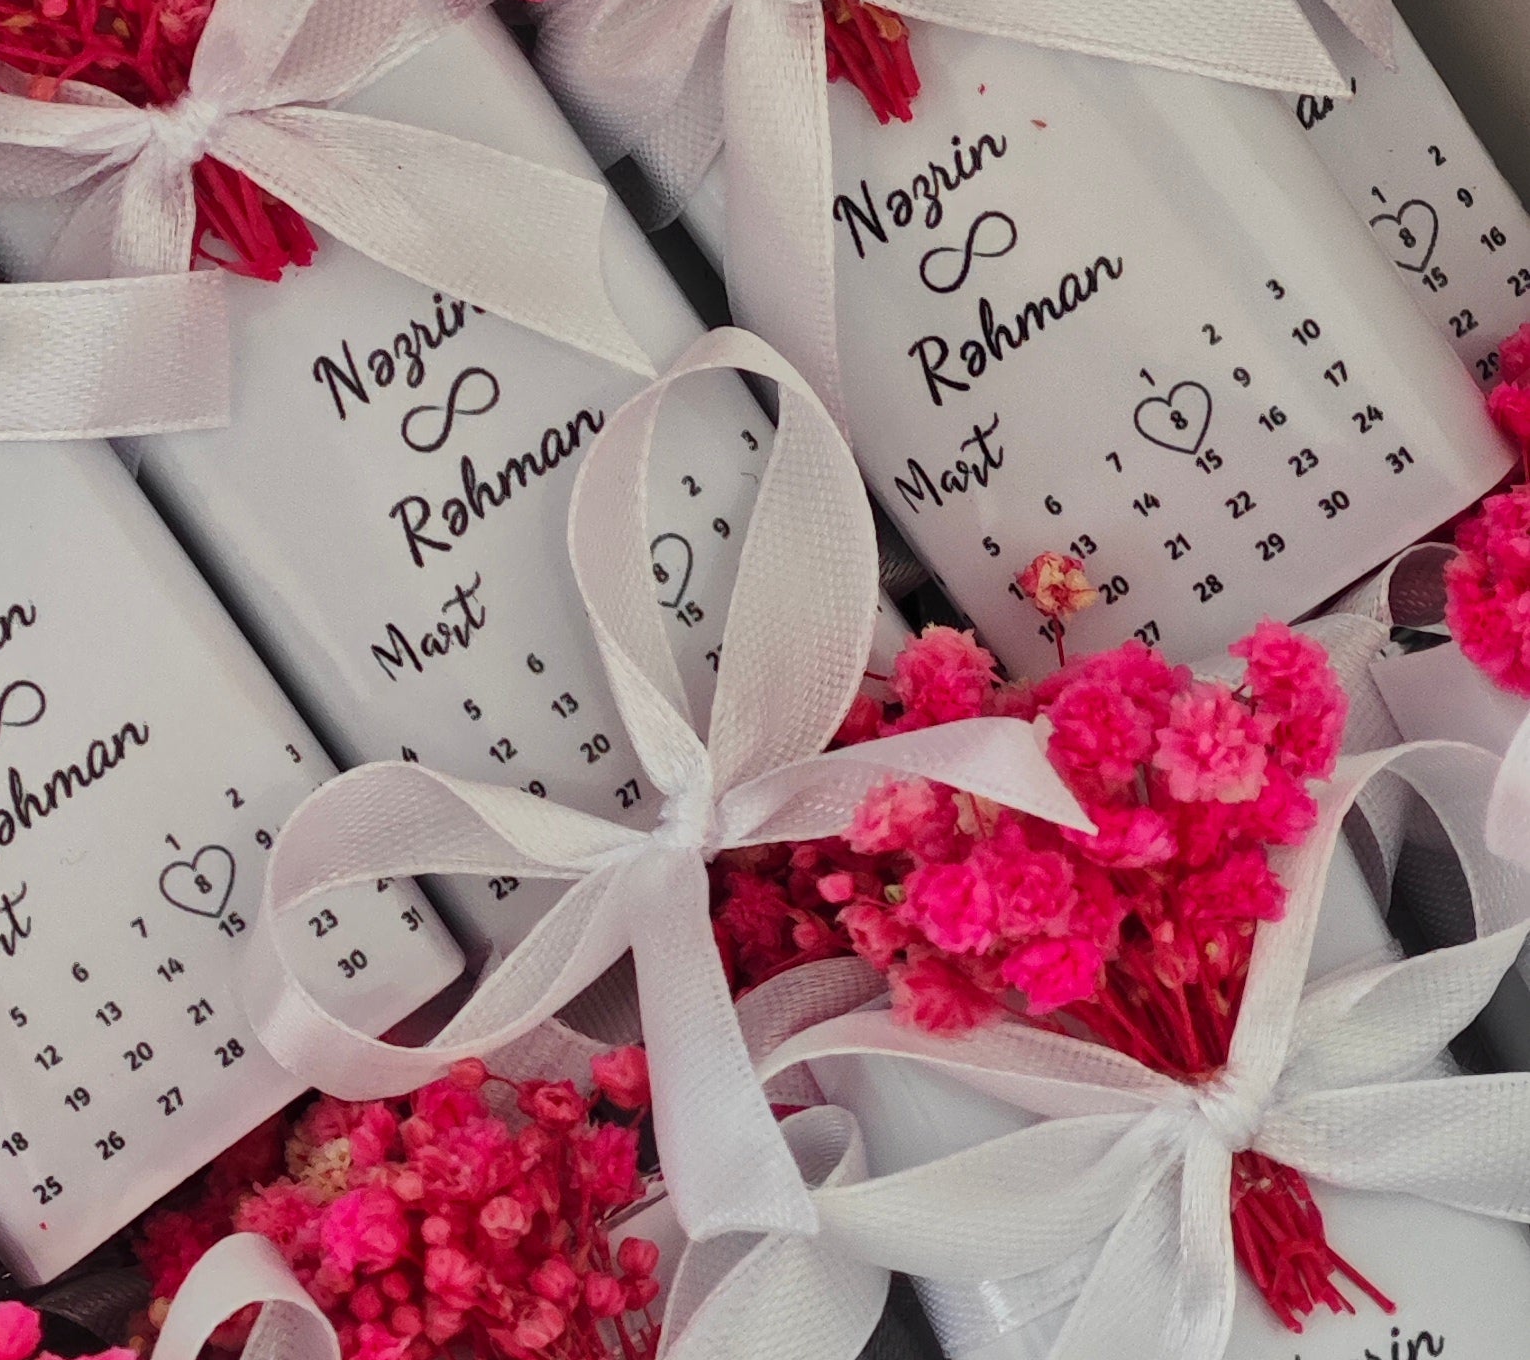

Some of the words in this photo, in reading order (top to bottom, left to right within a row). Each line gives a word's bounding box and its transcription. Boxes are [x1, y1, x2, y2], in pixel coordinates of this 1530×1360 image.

[832, 134, 1007, 259] Nəzrin
[1371, 186, 1387, 203] 1
[1428, 145, 1447, 166] 2
[1398, 227, 1416, 248] 8
[1457, 188, 1473, 208] 9
[1422, 266, 1448, 292] 15
[1480, 226, 1506, 252] 16
[908, 256, 1123, 406] Rəhman
[1139, 368, 1155, 387] 1
[1202, 324, 1222, 346] 2
[1266, 279, 1285, 300] 3
[1449, 309, 1479, 338] 22
[389, 409, 605, 568] Rəhman
[681, 475, 702, 497] 2
[741, 430, 759, 451] 3
[894, 412, 1004, 514] Mart
[982, 536, 1000, 557] 5
[1044, 495, 1062, 515] 6
[1105, 451, 1122, 473] 7
[1170, 410, 1188, 430] 8
[1233, 367, 1251, 388] 9
[1292, 319, 1321, 346] 10
[1070, 534, 1098, 559] 13
[1133, 492, 1161, 517] 14
[1195, 448, 1223, 474] 15
[1258, 405, 1287, 432] 16
[1323, 360, 1348, 387] 17
[370, 571, 486, 682] Mart
[463, 699, 482, 721] 5
[526, 653, 545, 675] 6
[712, 517, 731, 540] 9
[489, 737, 518, 764] 12
[551, 692, 579, 719] 13
[676, 599, 705, 628] 15
[165, 833, 181, 850] 1
[225, 788, 245, 809] 2
[286, 744, 303, 763] 3
[580, 733, 611, 764] 20
[615, 778, 641, 809] 27
[9, 1006, 27, 1028] 5
[71, 962, 89, 983] 6
[130, 917, 147, 938] 7
[194, 874, 212, 894] 8
[255, 829, 274, 850] 9
[34, 1045, 63, 1071] 12
[95, 1001, 122, 1026] 13
[157, 957, 185, 982] 14
[218, 911, 247, 938] 15
[32, 1176, 63, 1205] 25
[94, 1130, 125, 1160] 26
[156, 1086, 183, 1116] 27
[214, 1038, 246, 1068] 28
[338, 949, 368, 979] 30
[401, 906, 424, 932] 31
